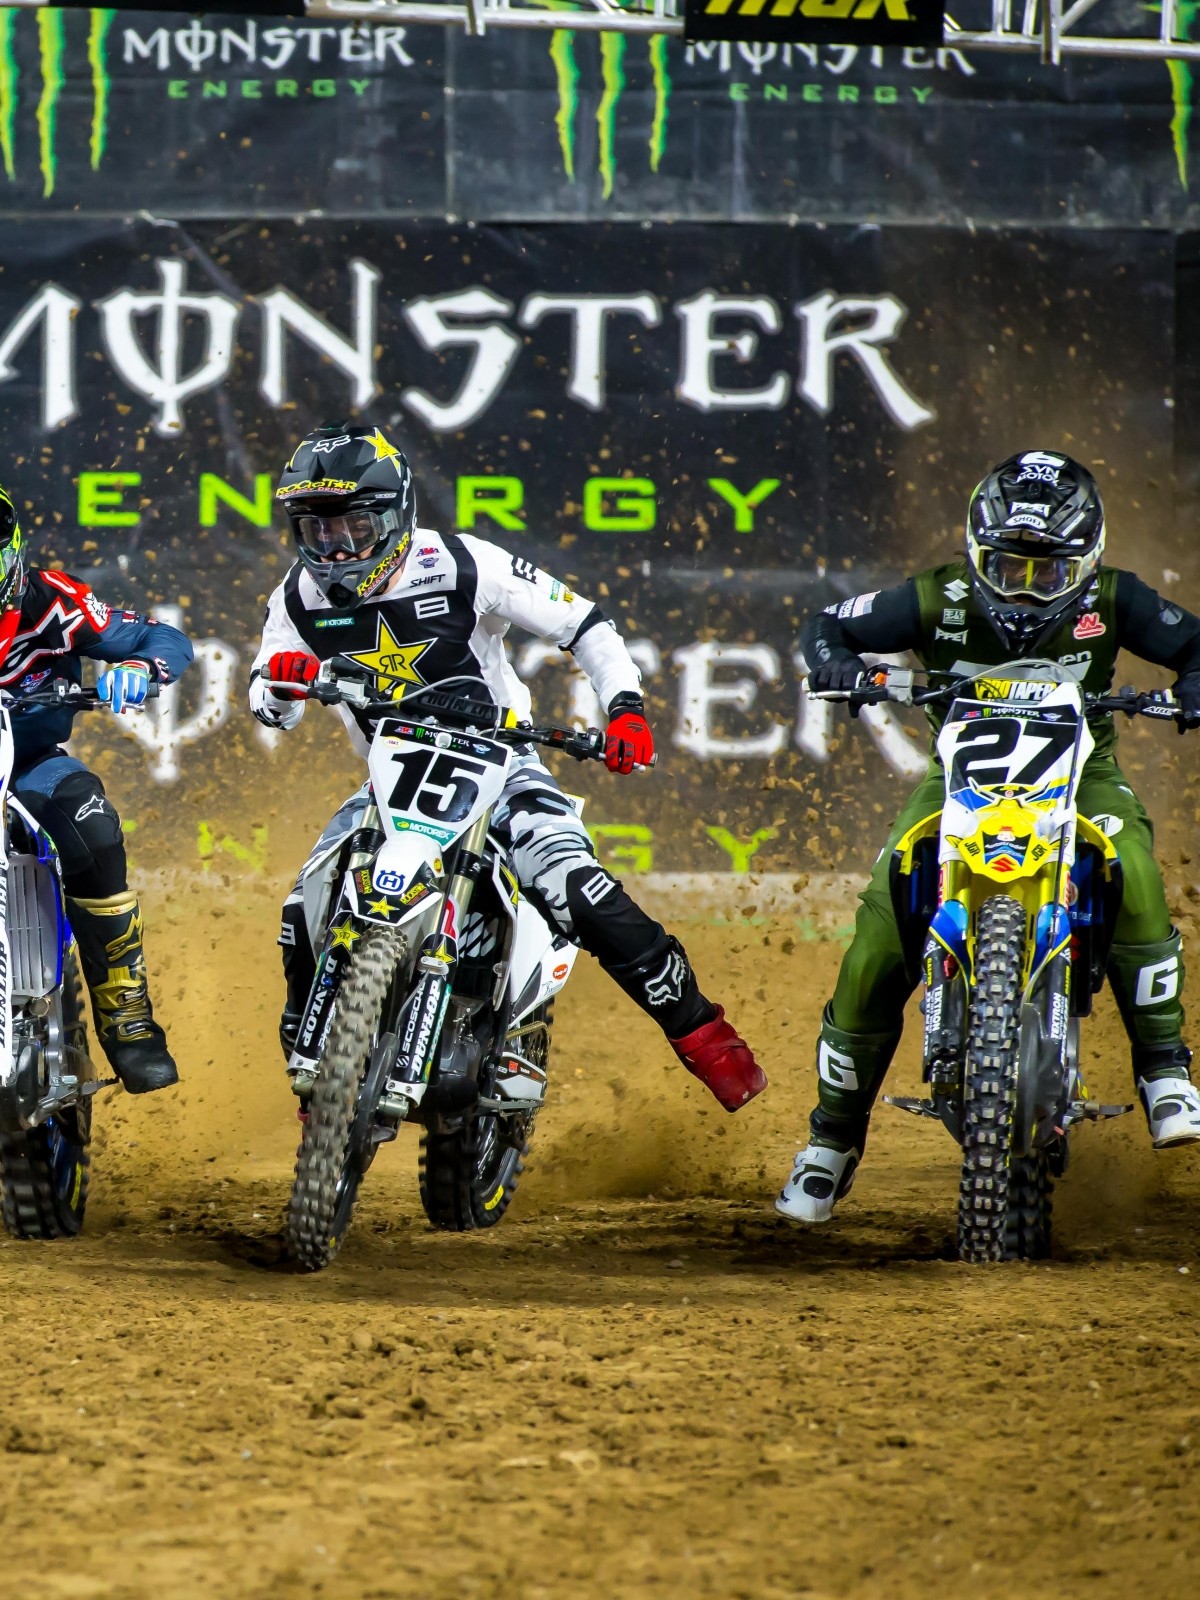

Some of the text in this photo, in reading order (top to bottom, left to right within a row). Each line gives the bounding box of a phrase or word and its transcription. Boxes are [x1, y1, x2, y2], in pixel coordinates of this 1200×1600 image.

[122, 19, 414, 72] MONSTER
[167, 79, 371, 99] ENERGY
[729, 82, 934, 104] ENERGY
[276, 477, 358, 498] ROCKSTAR
[78, 472, 782, 532] ENRGY
[410, 573, 446, 589] SHIFT
[992, 707, 1040, 718] MONSTER
[950, 718, 1077, 792] 27
[387, 749, 487, 823] 15
[409, 822, 452, 840] MOTOREX
[411, 979, 441, 1075] DUNLOP
